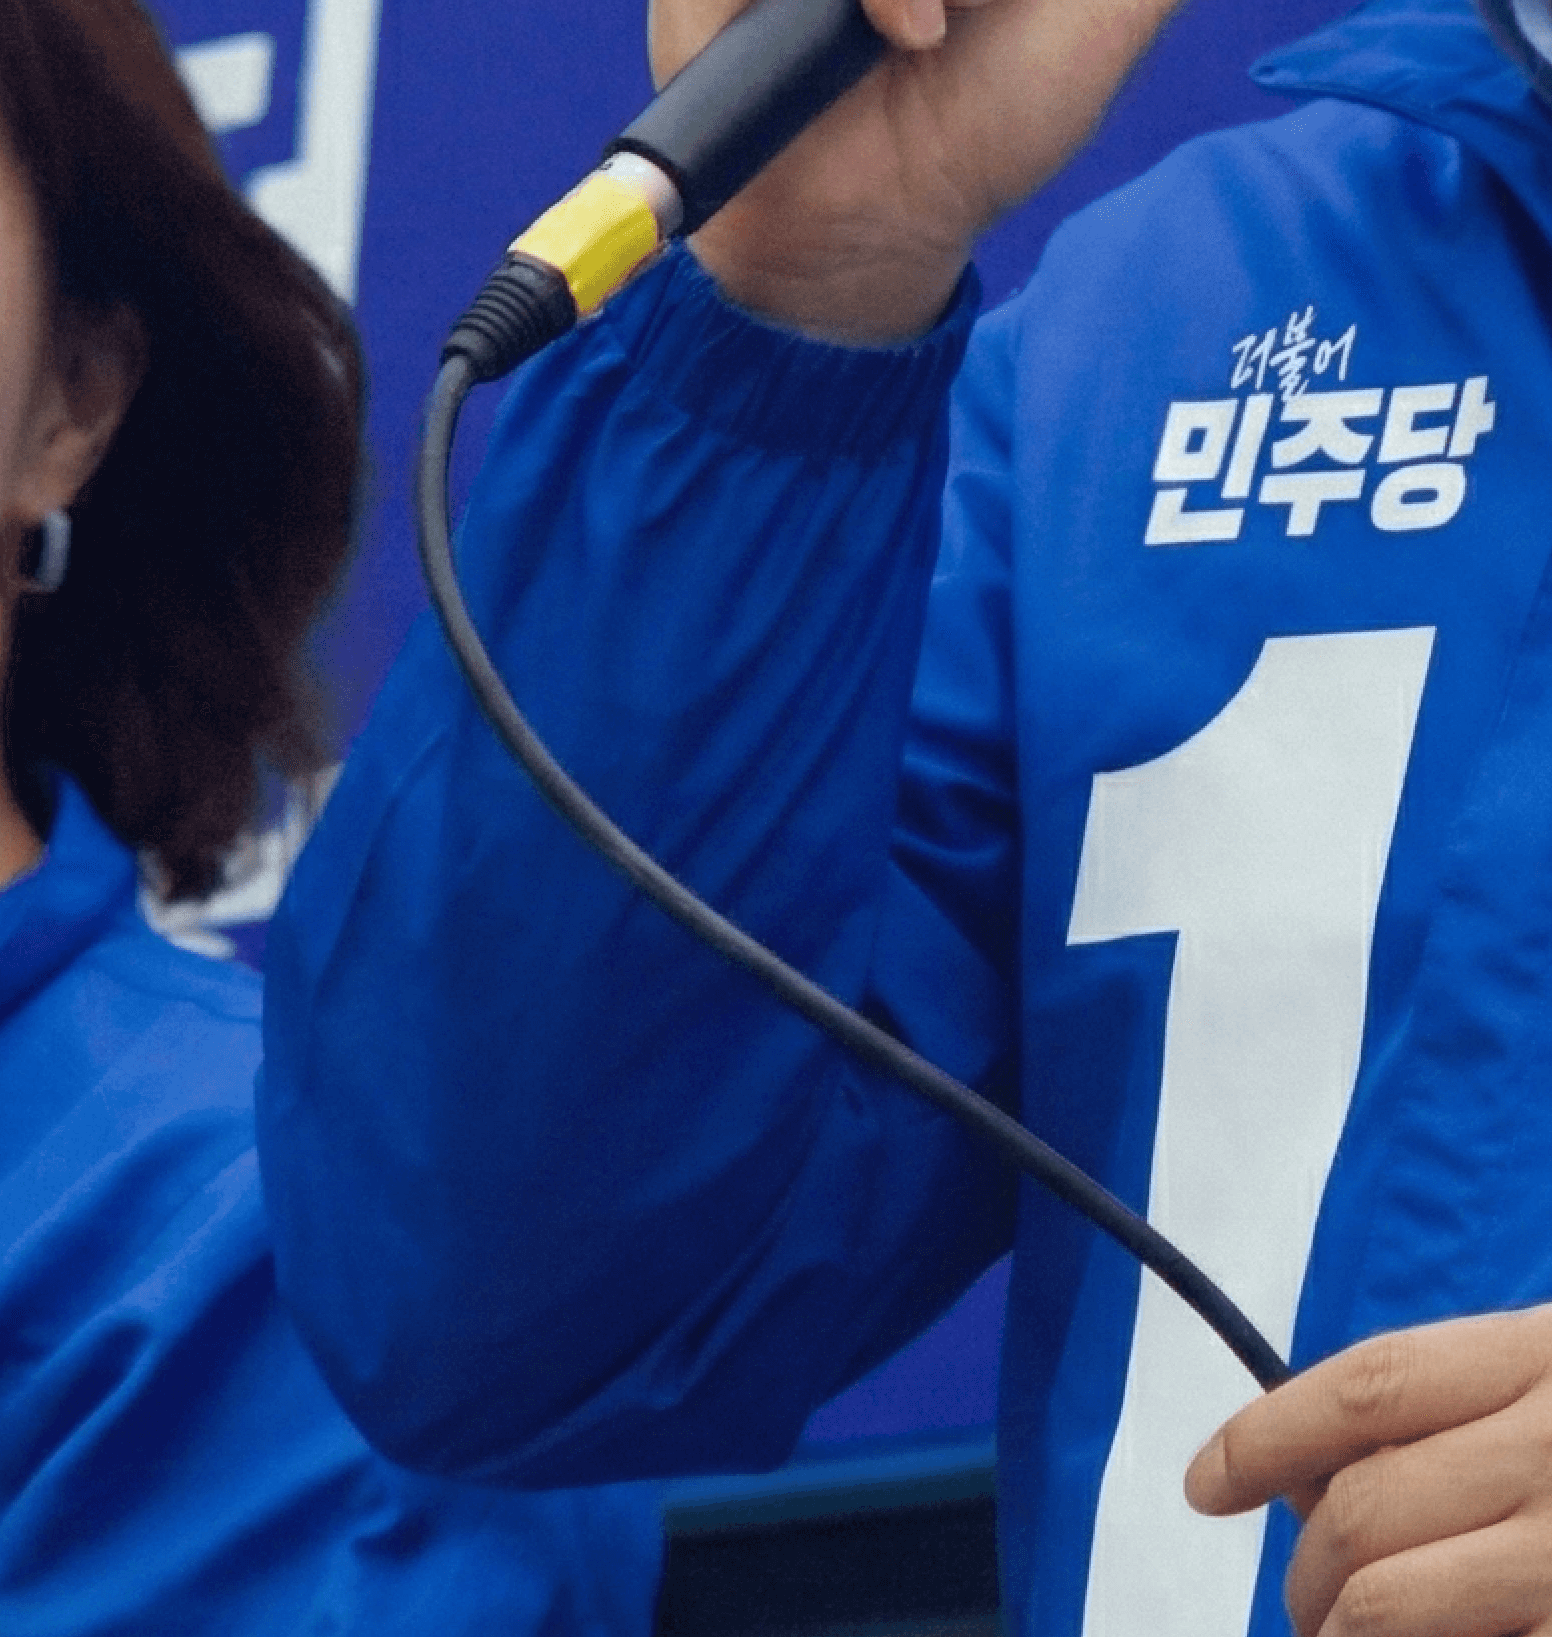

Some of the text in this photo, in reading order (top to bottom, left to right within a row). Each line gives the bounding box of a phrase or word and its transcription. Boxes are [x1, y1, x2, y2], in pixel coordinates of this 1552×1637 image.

[1230, 304, 1358, 403] 더불어
[1143, 375, 1496, 546] 민주당
[1065, 624, 1437, 1637] 1
